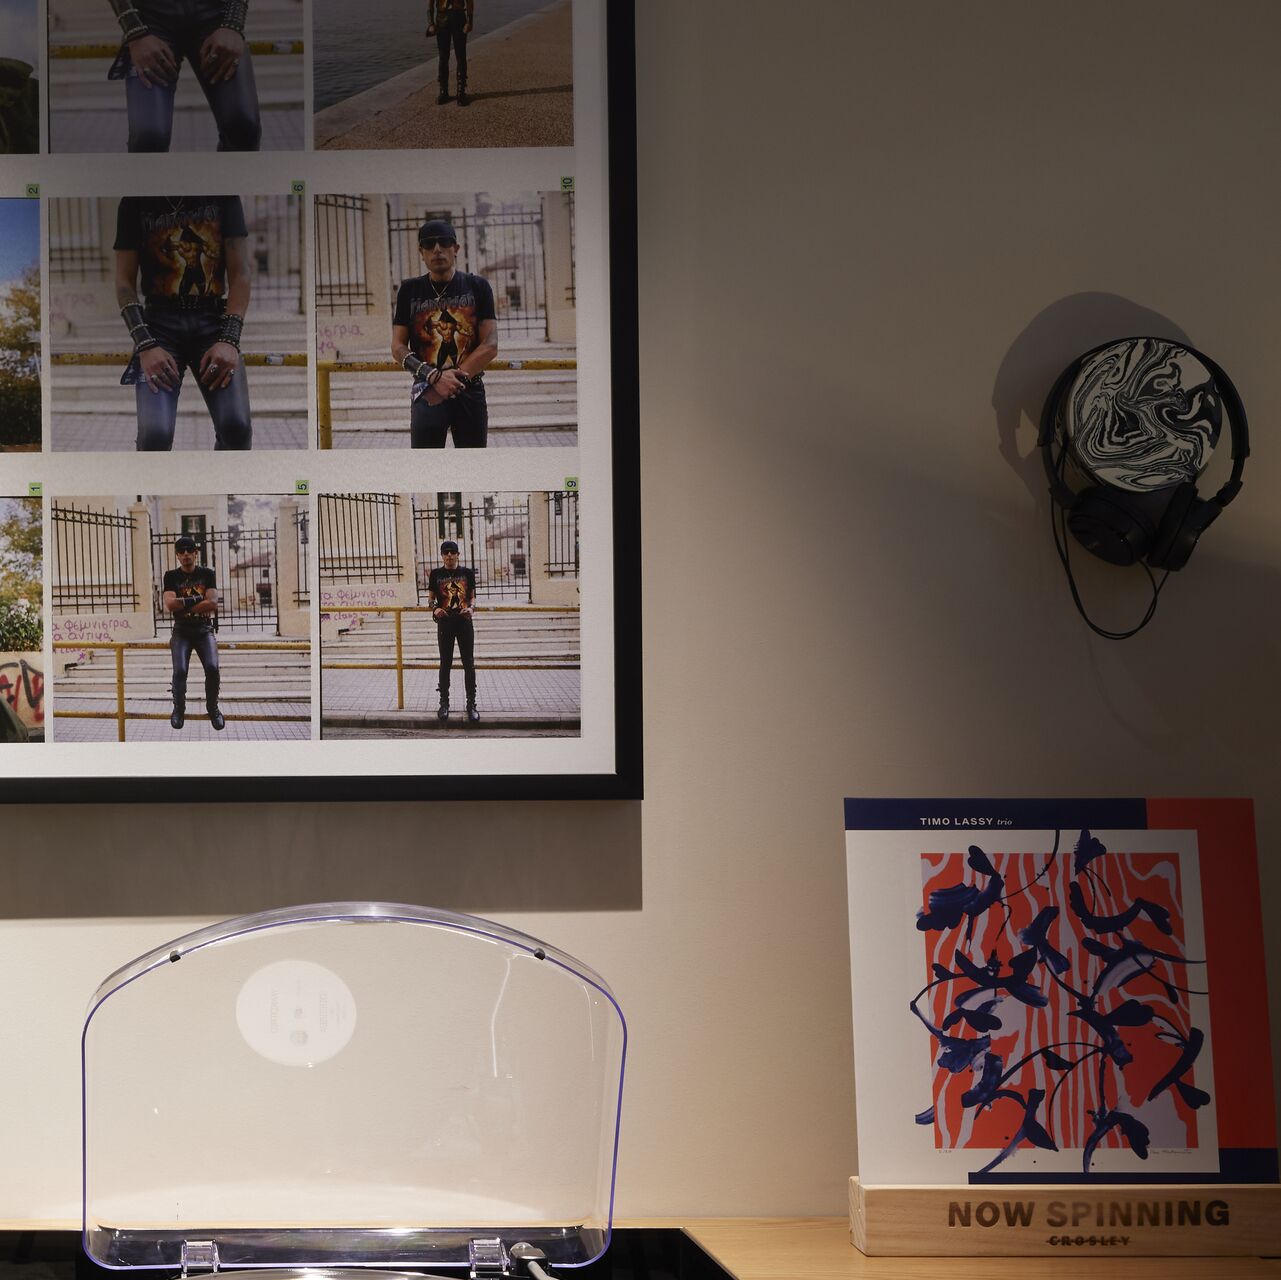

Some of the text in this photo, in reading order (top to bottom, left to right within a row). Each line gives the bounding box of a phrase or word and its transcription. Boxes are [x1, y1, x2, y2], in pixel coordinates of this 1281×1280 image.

[293, 184, 304, 192] 6
[562, 178, 573, 189] 10
[297, 483, 307, 491] 5
[919, 817, 1013, 826] TIMO LASSY trio
[947, 1199, 1230, 1228] NOW SPINNING
[1047, 1235, 1131, 1247] CROSLEY
